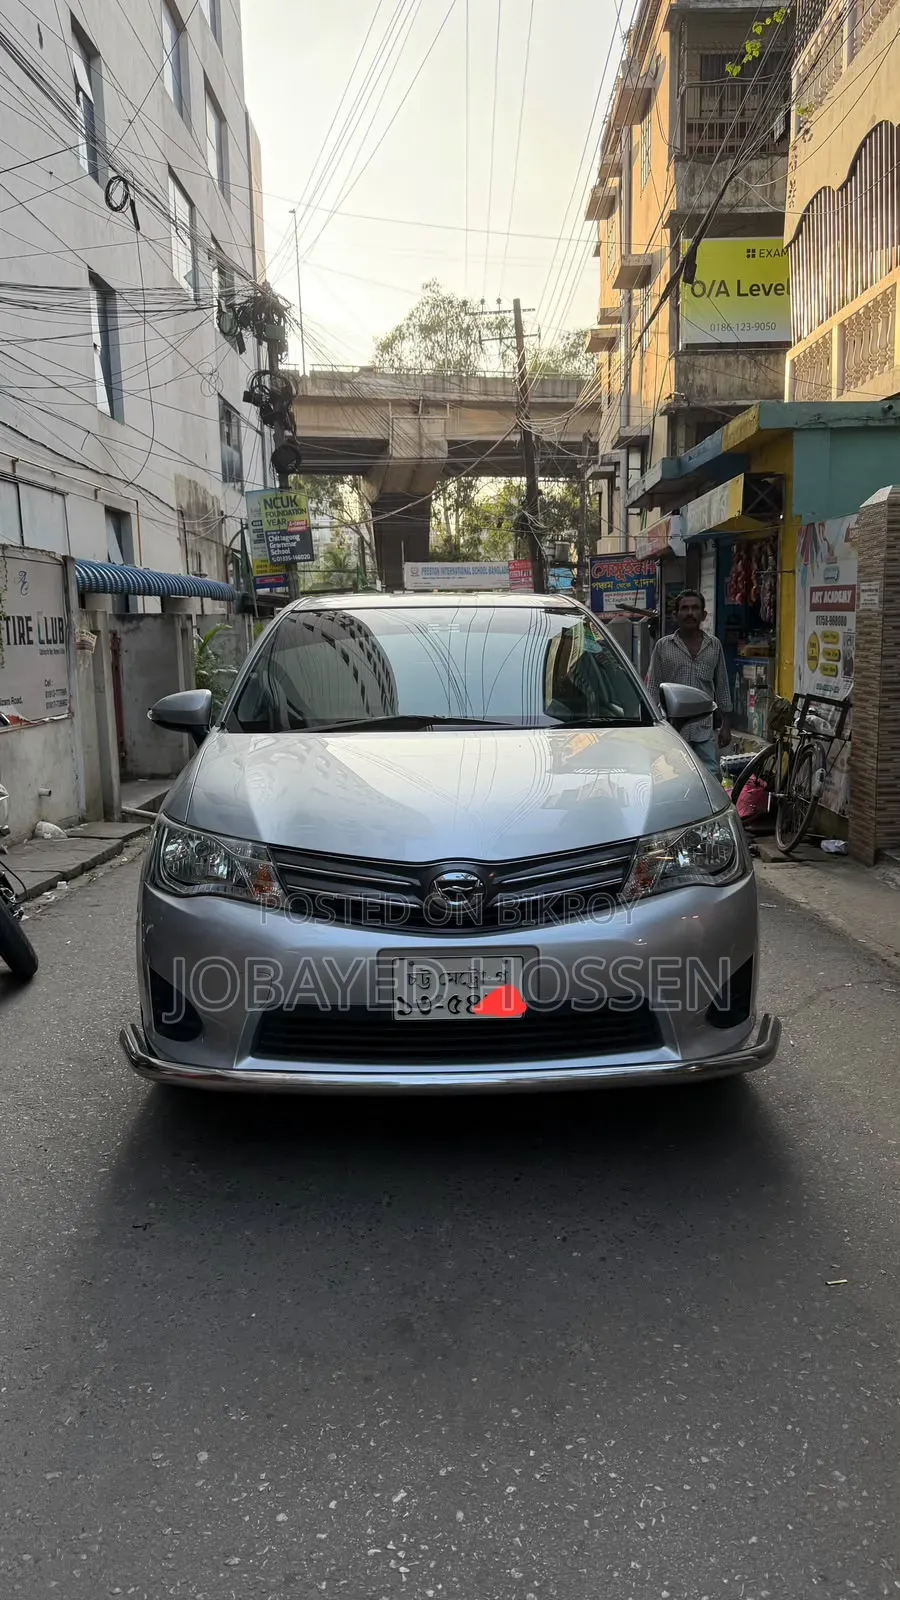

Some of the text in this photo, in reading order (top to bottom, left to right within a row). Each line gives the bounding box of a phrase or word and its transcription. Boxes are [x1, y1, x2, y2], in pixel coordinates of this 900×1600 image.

[691, 280, 730, 298] O/A
[710, 322, 777, 333] 0186-123-9050
[263, 495, 298, 510] NCUK
[265, 508, 307, 518] FOUNDATION
[267, 518, 287, 527] YEAR
[271, 548, 291, 556] School
[472, 566, 487, 575] SCHOOL
[812, 592, 824, 604] ART
[824, 590, 852, 604] ACADEMY
[0, 615, 33, 646] TIRE
